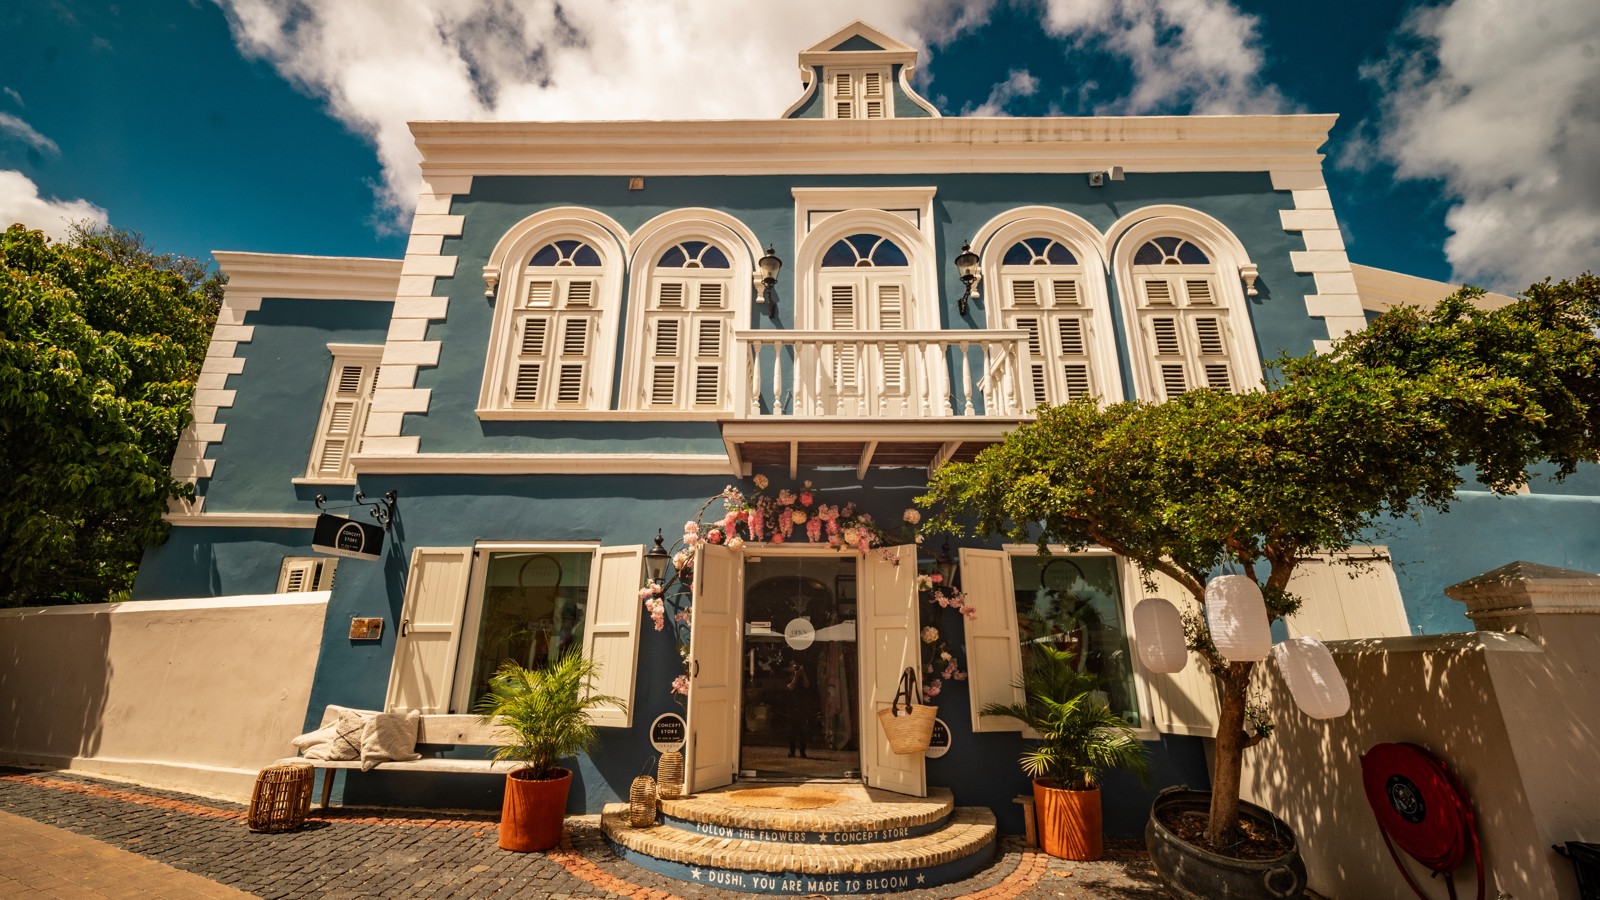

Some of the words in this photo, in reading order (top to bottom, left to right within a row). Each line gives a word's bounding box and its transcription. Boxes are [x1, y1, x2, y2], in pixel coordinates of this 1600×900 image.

[696, 823, 734, 838] FOLLOW
[739, 829, 755, 839] THE
[760, 831, 806, 841] FLOWERS
[834, 831, 879, 842] CONCEPT
[882, 827, 908, 840] STORE
[708, 871, 746, 888] DUSHI,
[753, 877, 776, 890] YOU
[781, 880, 802, 891] ARE
[807, 881, 839, 892] MADE
[845, 880, 860, 892] TO
[866, 876, 908, 891] BLOOM
